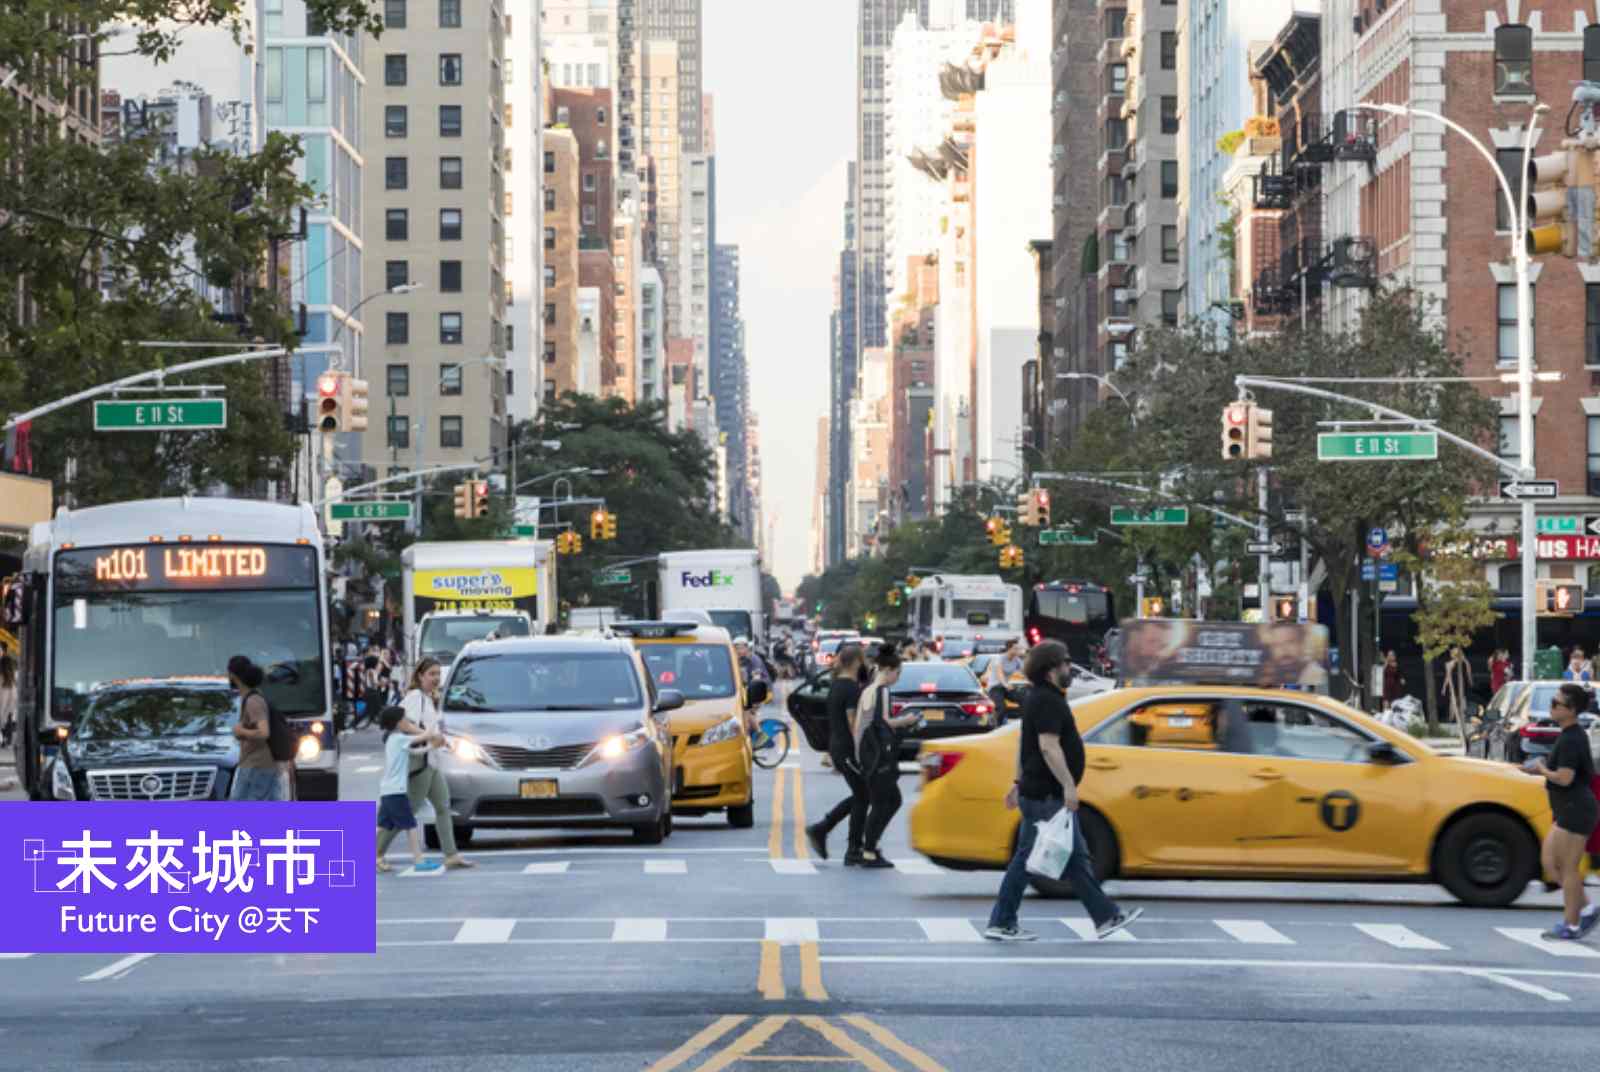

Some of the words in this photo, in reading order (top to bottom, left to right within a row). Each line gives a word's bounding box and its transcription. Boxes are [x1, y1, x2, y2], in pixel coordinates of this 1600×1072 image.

[135, 406, 145, 424] E
[152, 406, 161, 424] 11
[167, 406, 184, 423] St
[1355, 438, 1365, 454] E
[1369, 438, 1379, 454] 11
[1384, 438, 1399, 454] St
[165, 549, 267, 577] LIMITED
[681, 571, 734, 588] FedEx
[460, 585, 512, 596] moving
